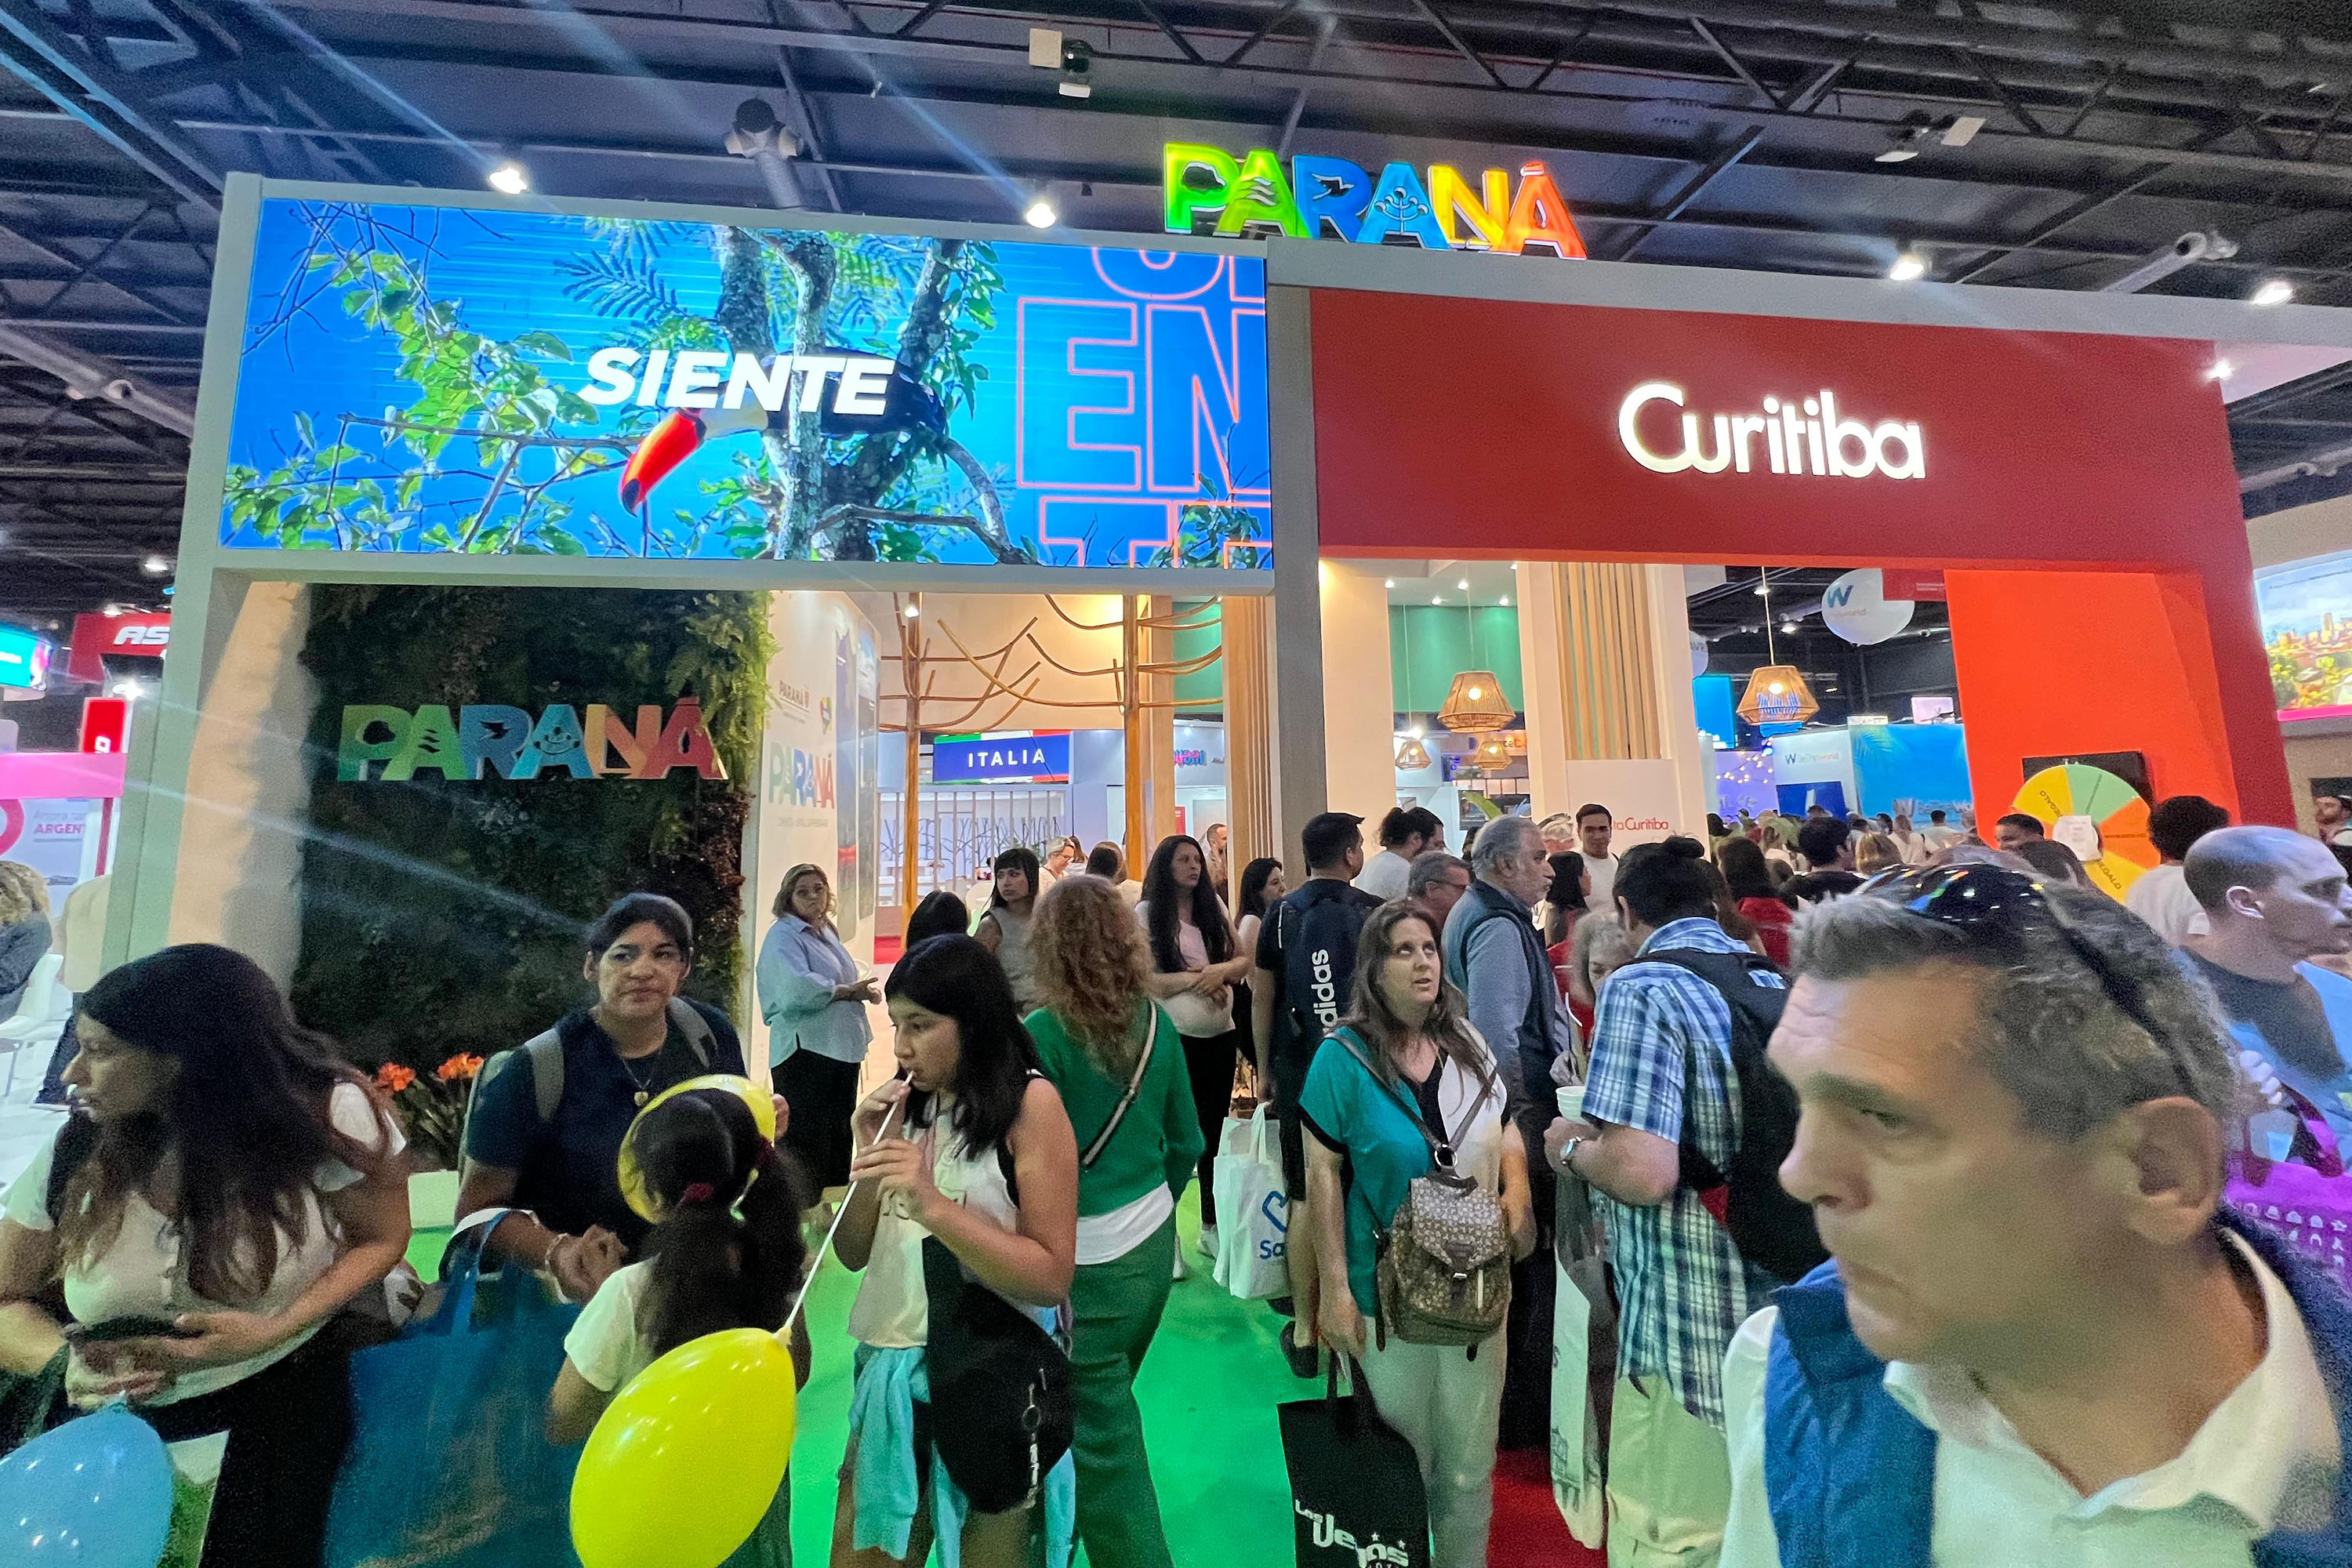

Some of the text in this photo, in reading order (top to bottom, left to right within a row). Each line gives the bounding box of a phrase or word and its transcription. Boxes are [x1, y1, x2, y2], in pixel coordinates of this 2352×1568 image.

[1163, 143, 1588, 261] PARANÁ
[577, 347, 895, 416] SIENTE
[1618, 383, 1926, 480] Curitiba
[338, 697, 729, 782] PARANÁ
[968, 749, 1045, 768] ITALIA
[768, 741, 835, 810] PARANÁ
[1625, 817, 1669, 830] Curitiba
